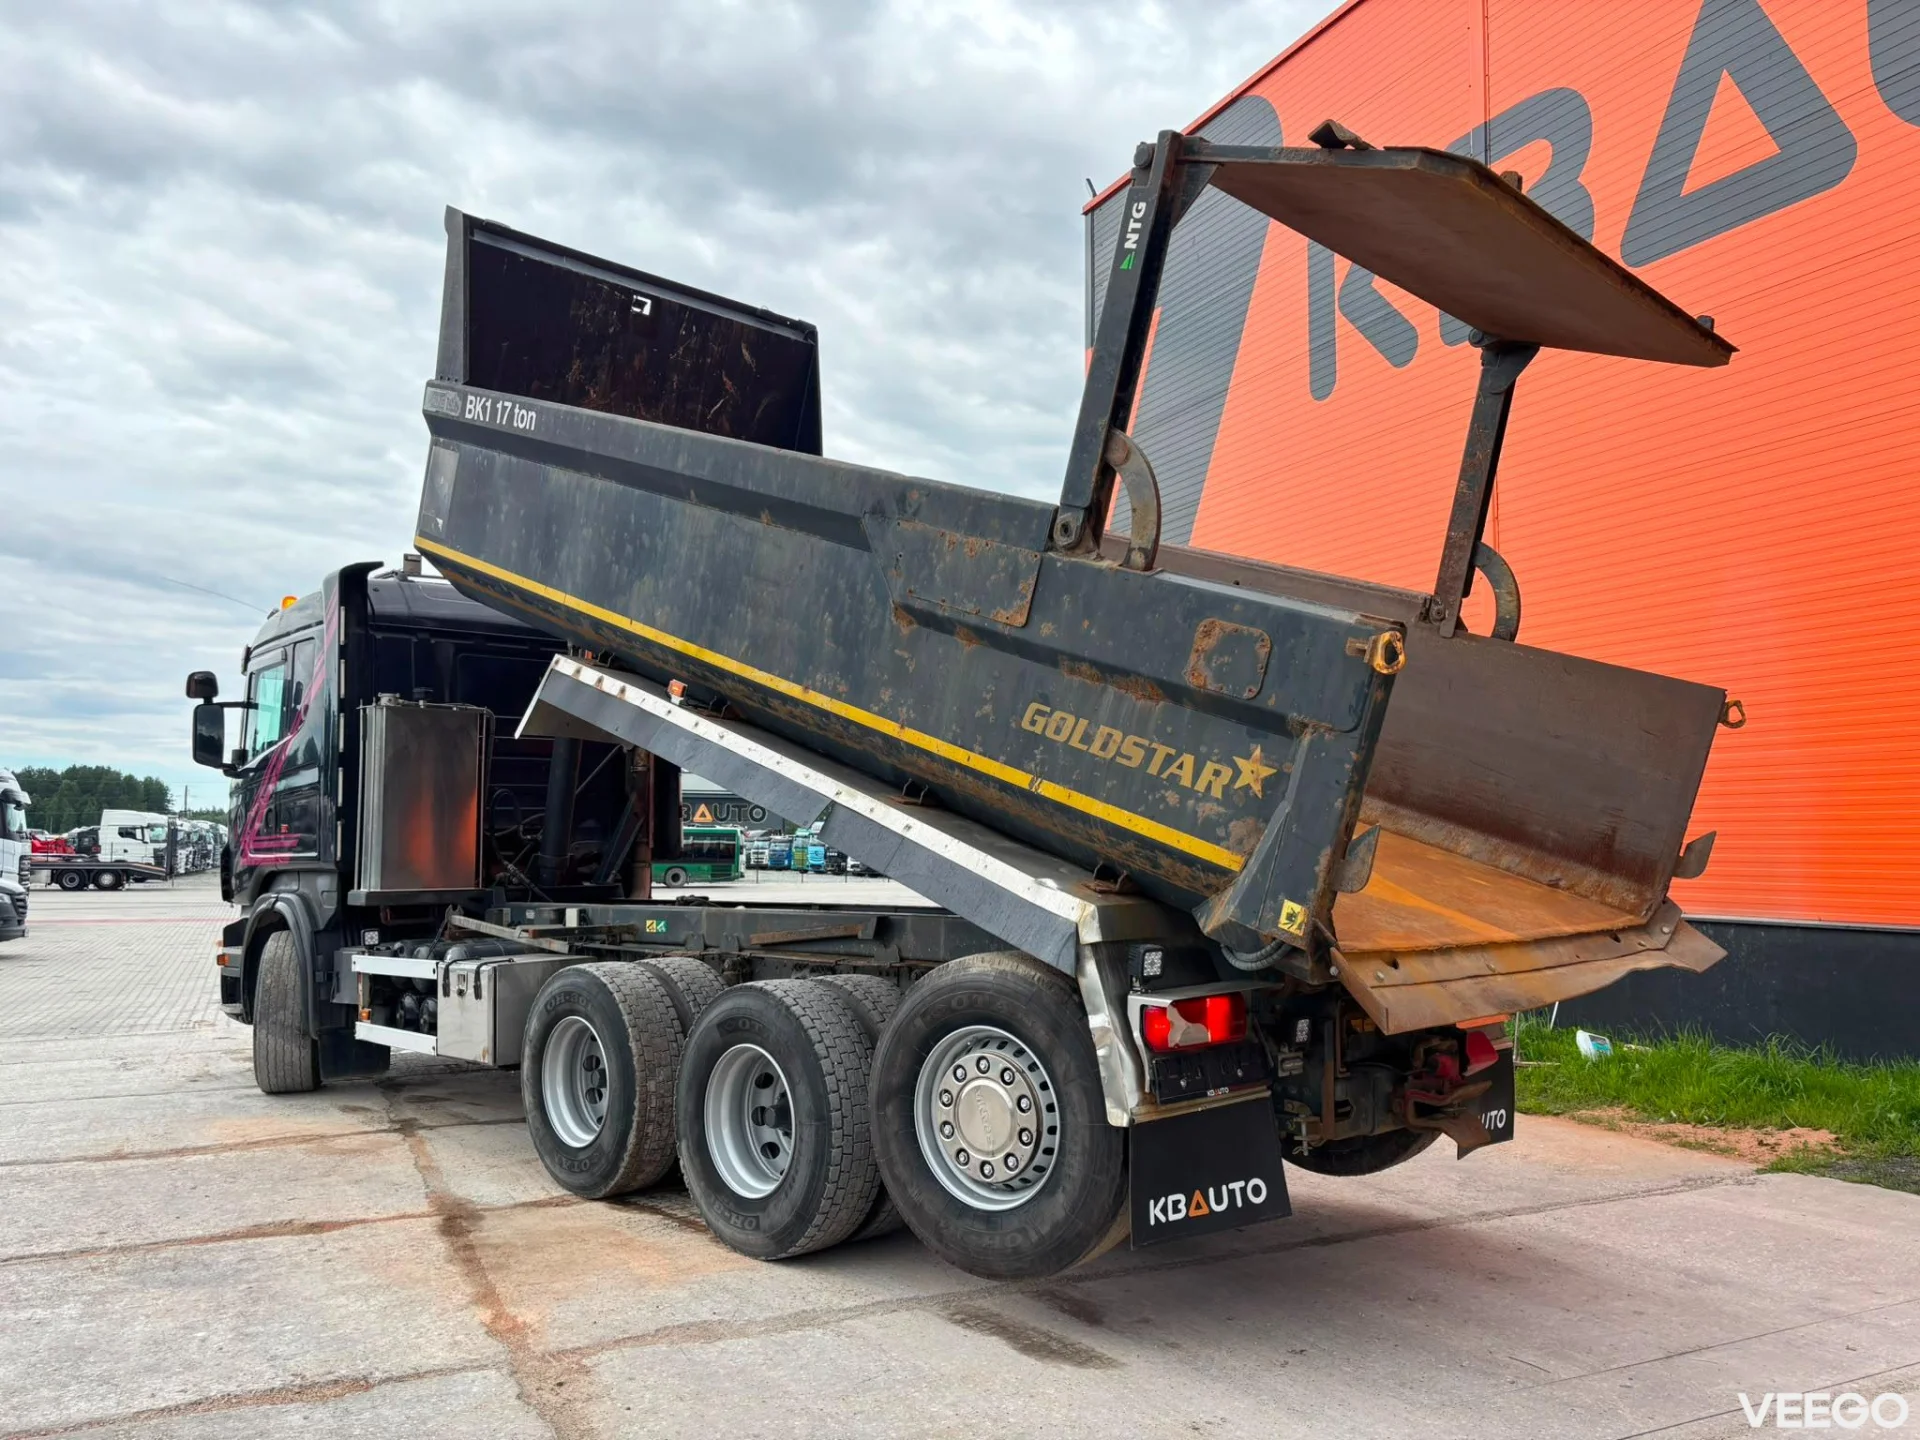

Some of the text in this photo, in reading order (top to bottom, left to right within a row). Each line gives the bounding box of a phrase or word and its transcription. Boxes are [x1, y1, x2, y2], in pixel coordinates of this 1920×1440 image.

[1124, 202, 1147, 249] NTG
[465, 395, 492, 422] BK1
[496, 400, 512, 425] 17
[513, 404, 537, 431] ton
[1021, 702, 1233, 799] GOLDSTAR
[1149, 1178, 1267, 1226] KBAUTO
